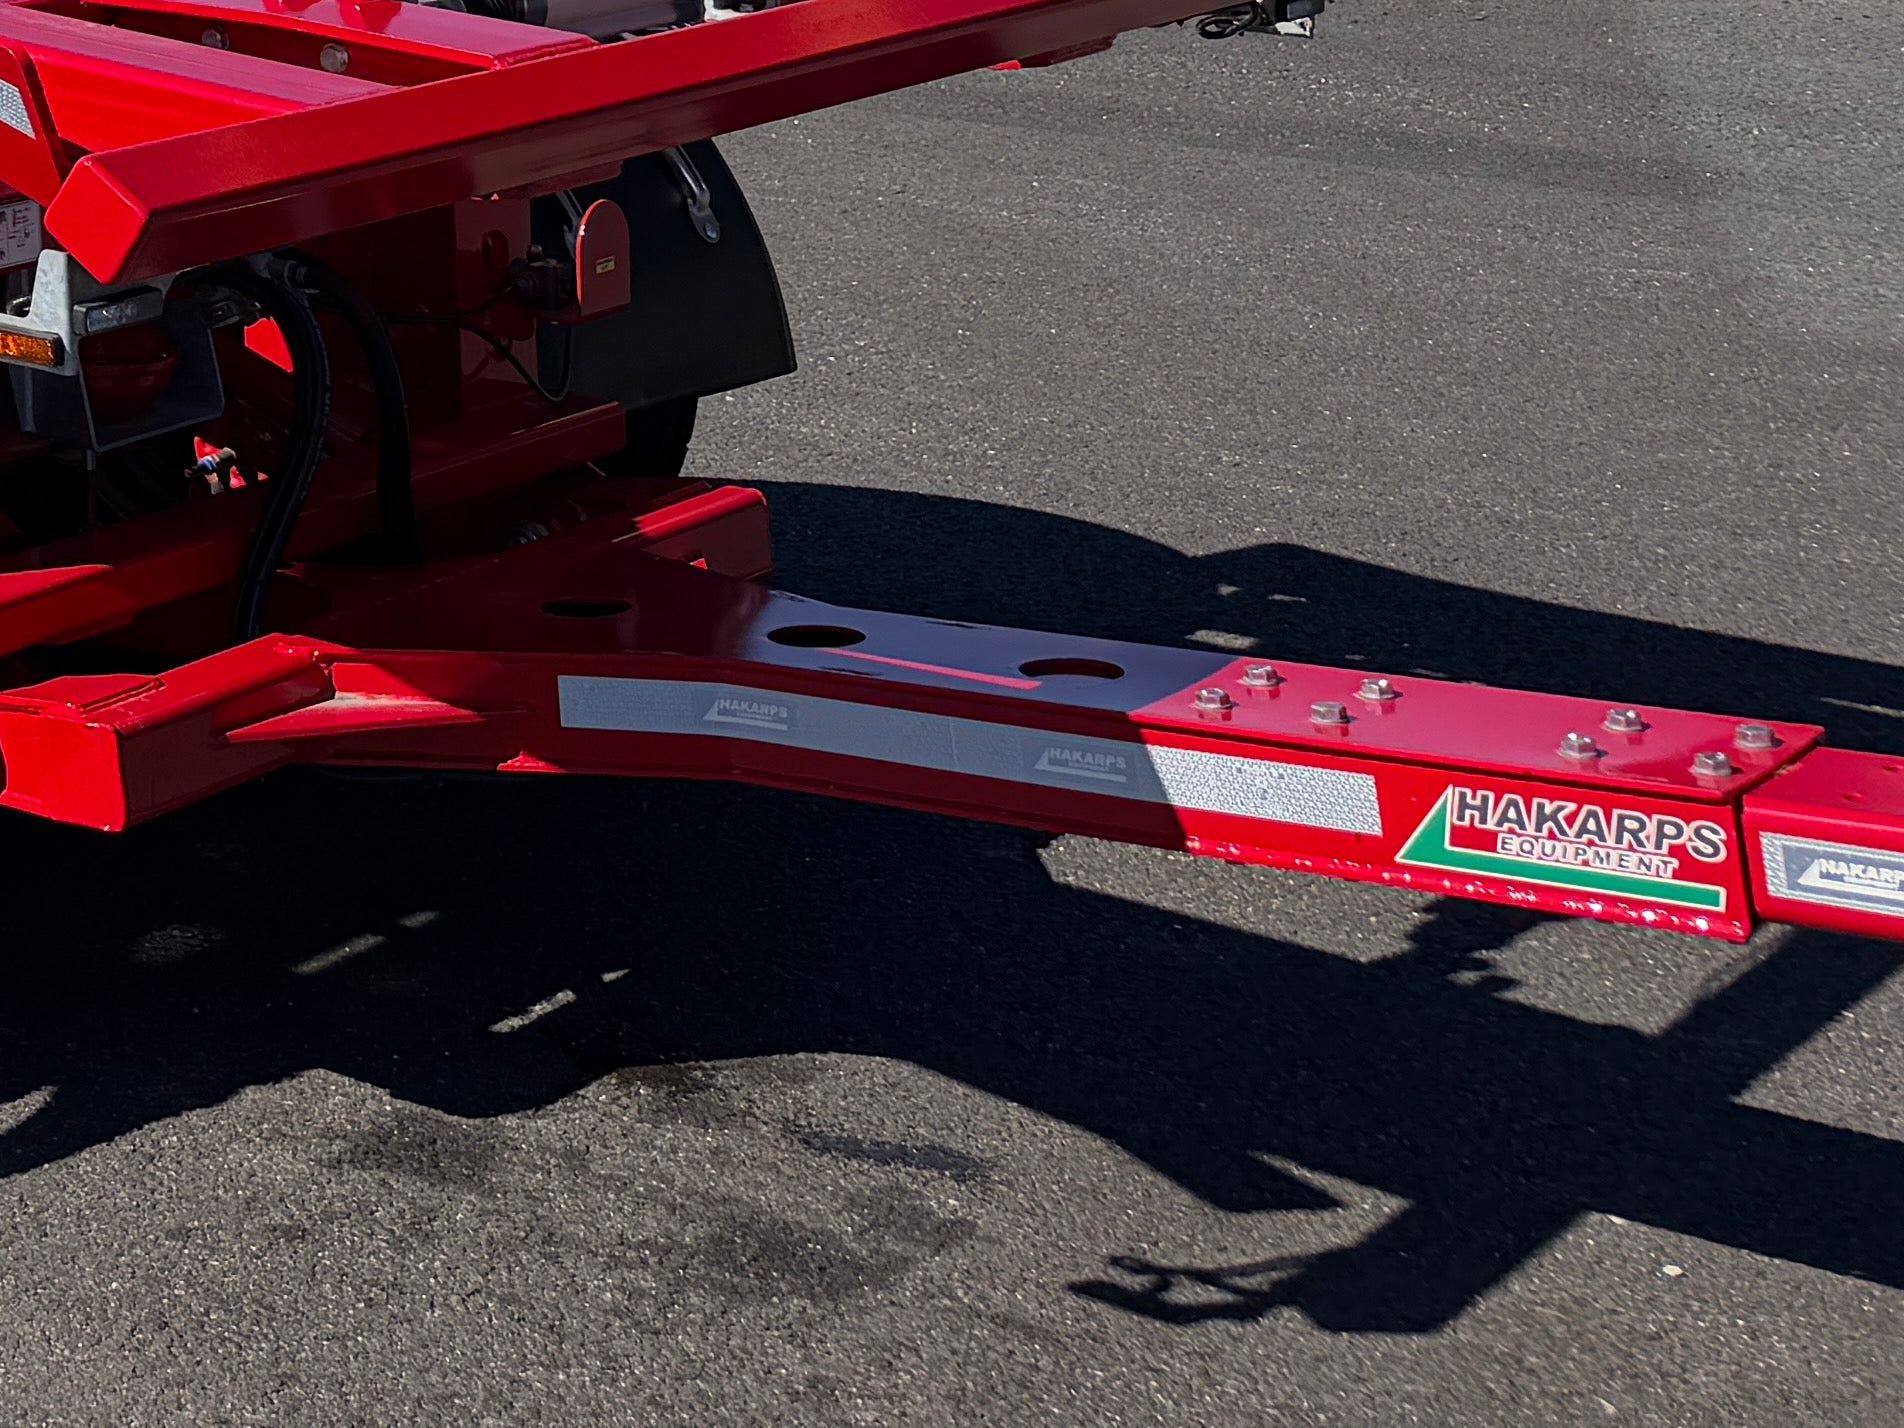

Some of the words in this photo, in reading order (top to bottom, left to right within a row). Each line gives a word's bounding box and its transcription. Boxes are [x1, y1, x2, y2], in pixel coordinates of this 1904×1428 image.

[719, 699, 789, 718] HAKARPS
[1050, 747, 1127, 770] HAKARPS
[1456, 788, 1727, 861] HAKARPS
[1499, 835, 1677, 876] EQUIPMENT
